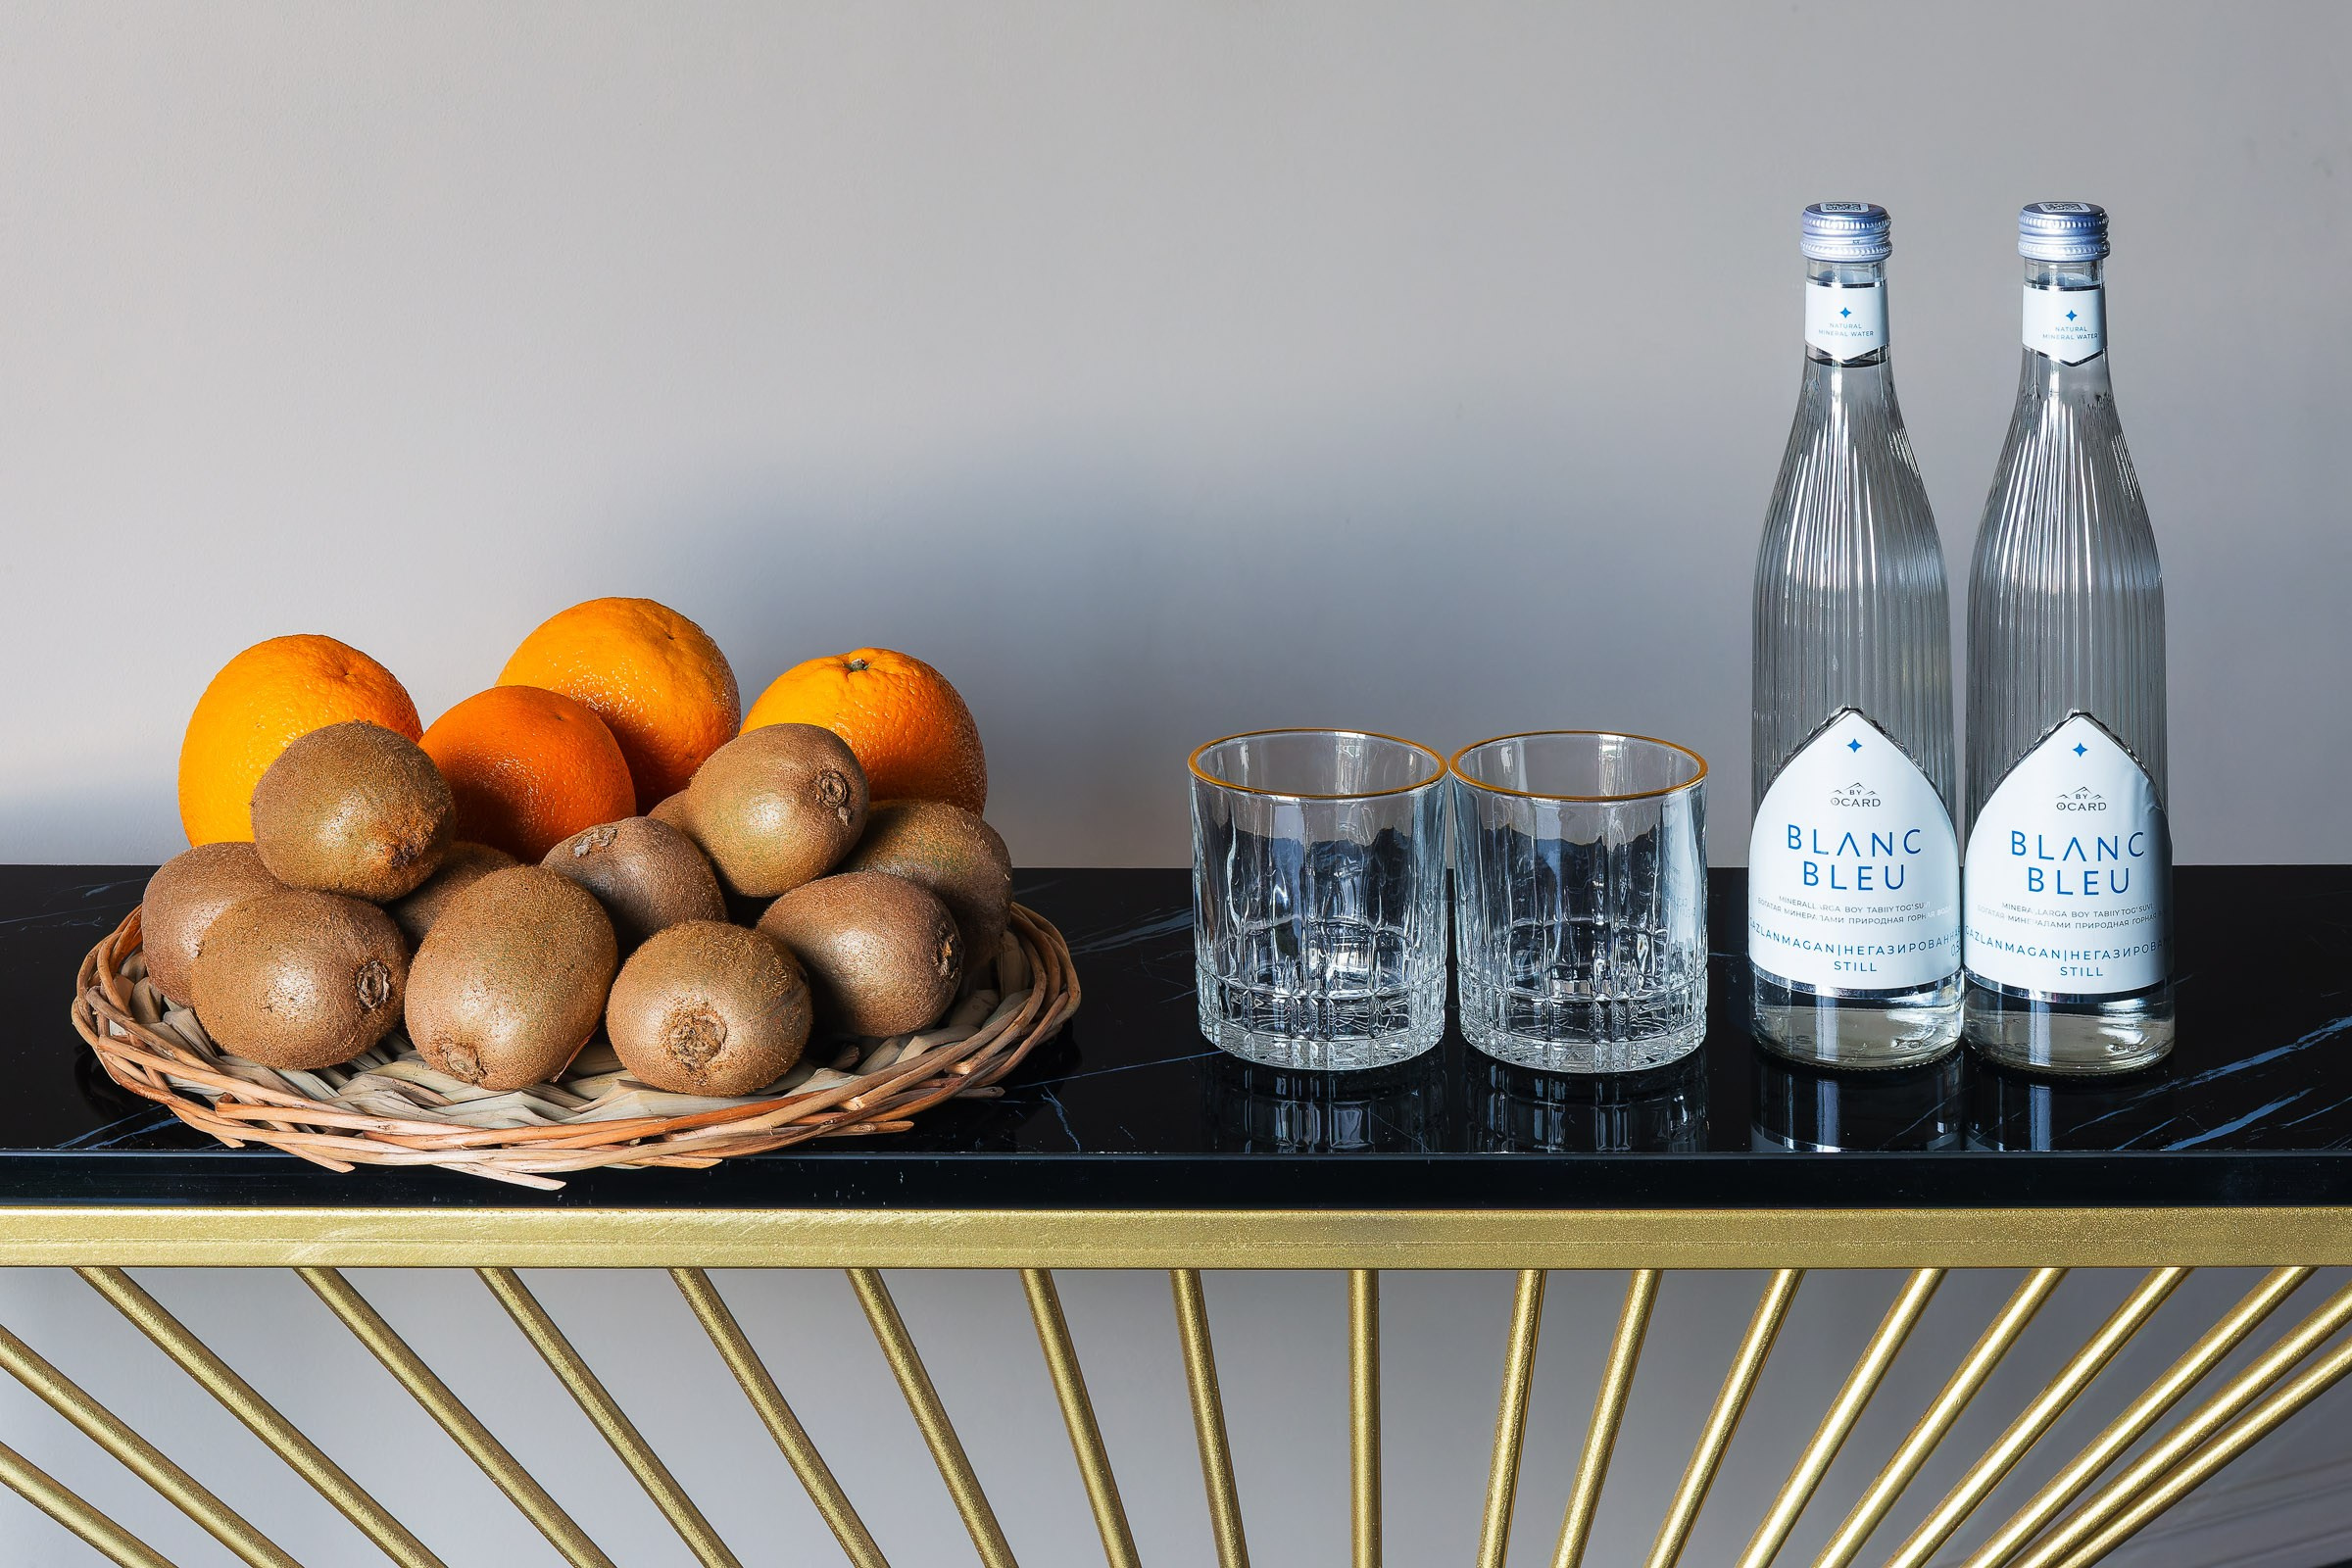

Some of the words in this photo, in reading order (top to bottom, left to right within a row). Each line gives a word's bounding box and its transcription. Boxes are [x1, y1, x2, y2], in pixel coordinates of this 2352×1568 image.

[1830, 797, 1882, 808] OCARD
[2056, 802, 2107, 811] OCARD
[1788, 824, 1921, 857] BLANC
[2011, 830, 2144, 861] BLANC
[1803, 860, 1904, 890] BLEU
[2028, 866, 2130, 895] BLEU
[1848, 916, 1904, 925] ПРИРОДНАЯ
[2075, 919, 2130, 929] ПРИРОДНАЯ
[1834, 960, 1878, 972] STILL
[2060, 966, 2104, 977] STILL
